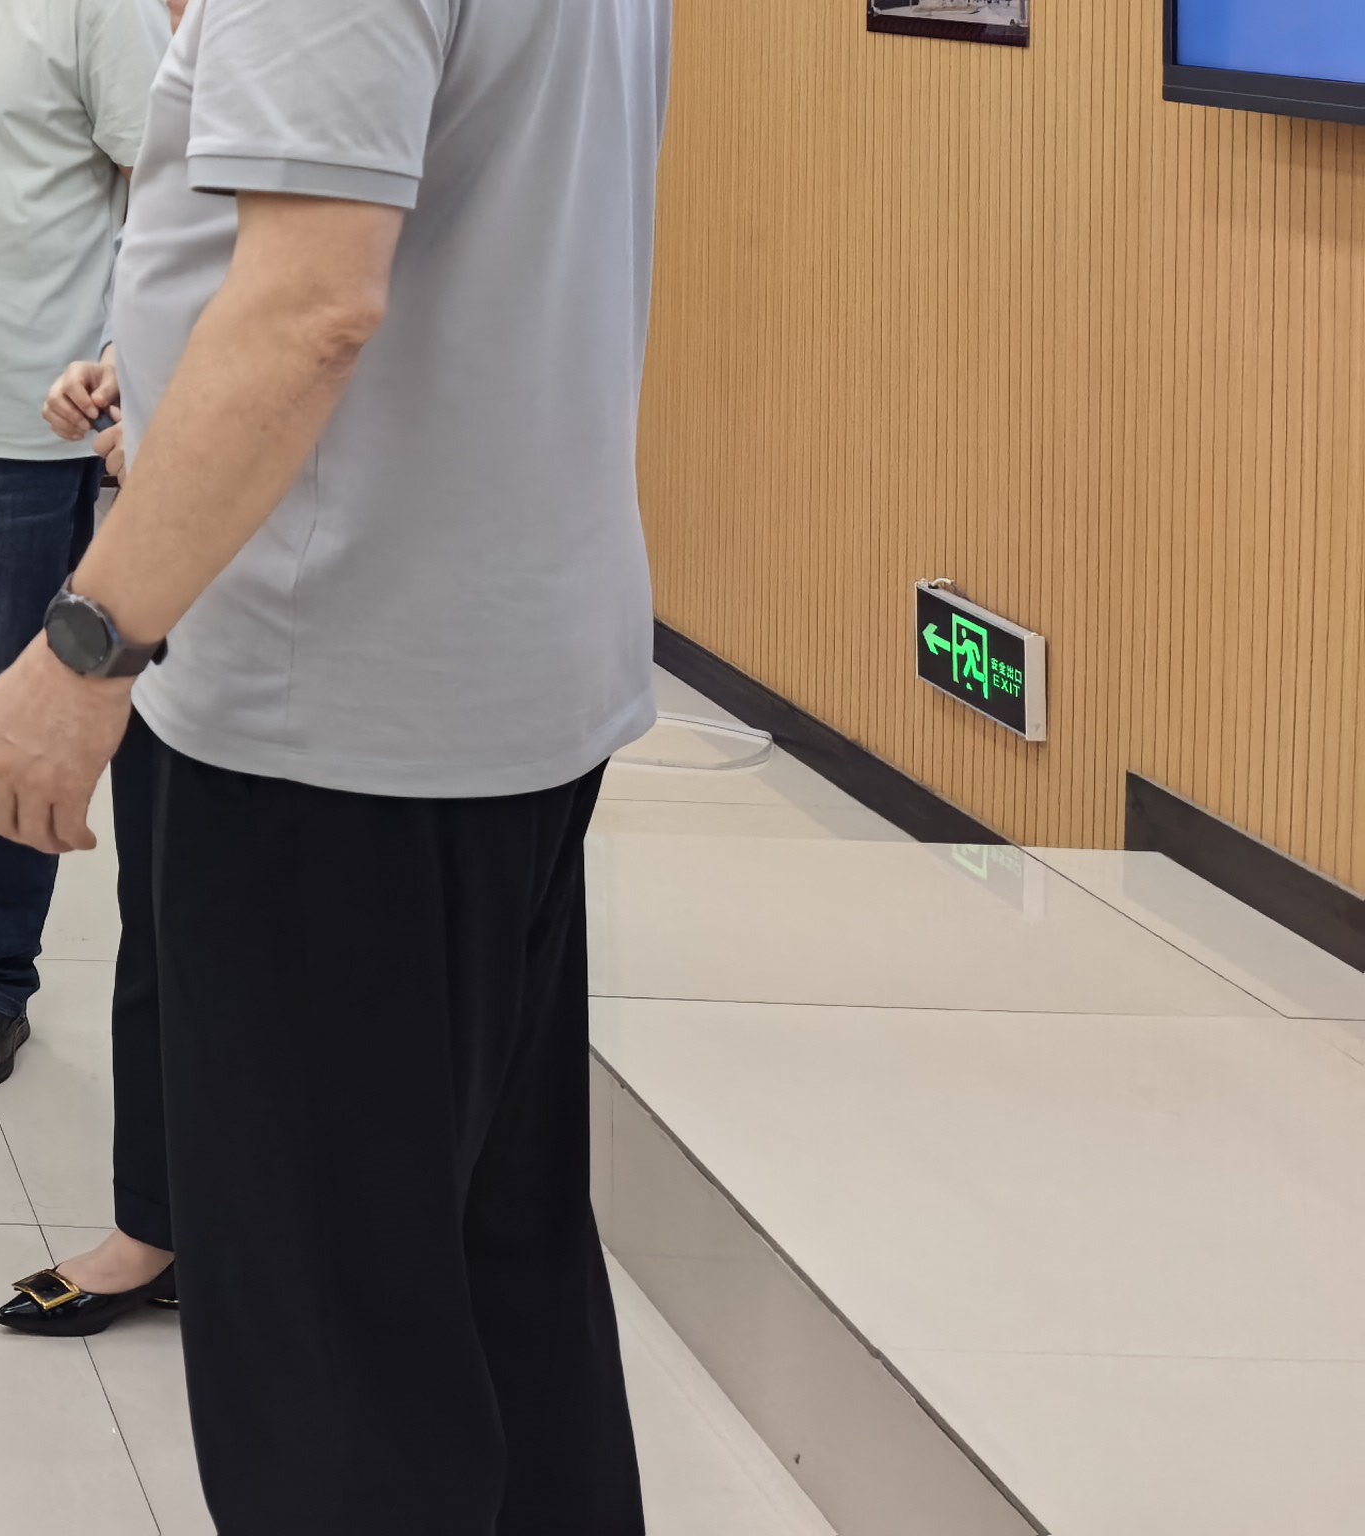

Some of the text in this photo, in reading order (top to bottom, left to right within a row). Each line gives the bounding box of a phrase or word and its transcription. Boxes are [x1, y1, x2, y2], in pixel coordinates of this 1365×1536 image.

[990, 657, 1023, 684] 安全出口
[993, 674, 1021, 698] EXIT
